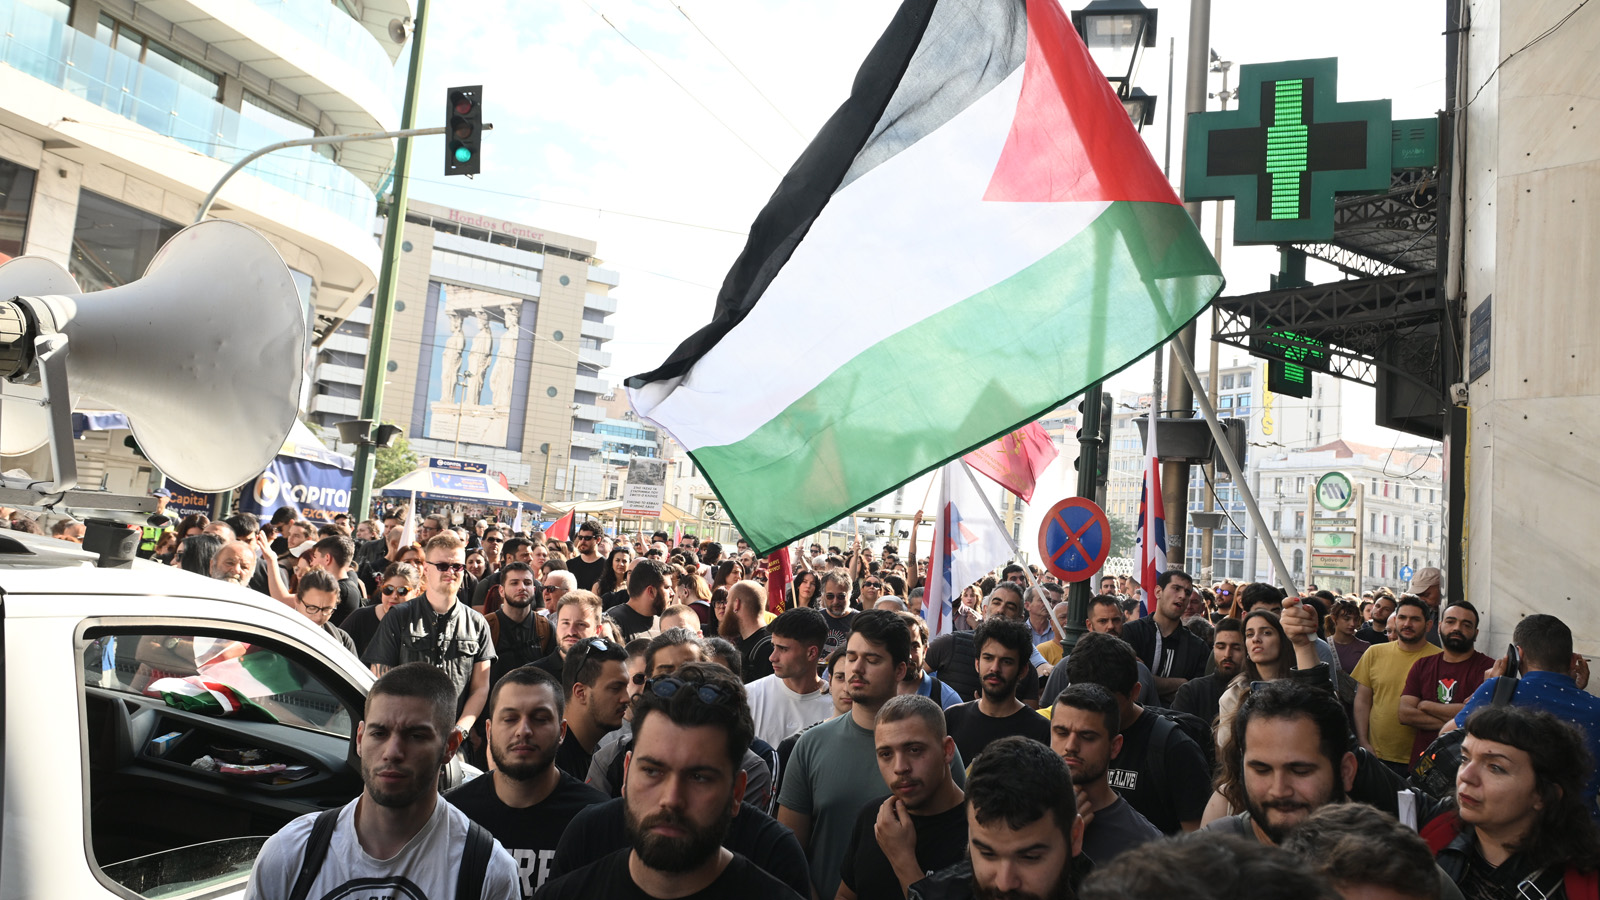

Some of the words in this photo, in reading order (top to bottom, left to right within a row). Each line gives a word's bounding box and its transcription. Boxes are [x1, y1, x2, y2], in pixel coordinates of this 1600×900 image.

[449, 209, 497, 229] Hondos
[501, 221, 545, 241] Center
[1114, 771, 1136, 788] ALIVE
